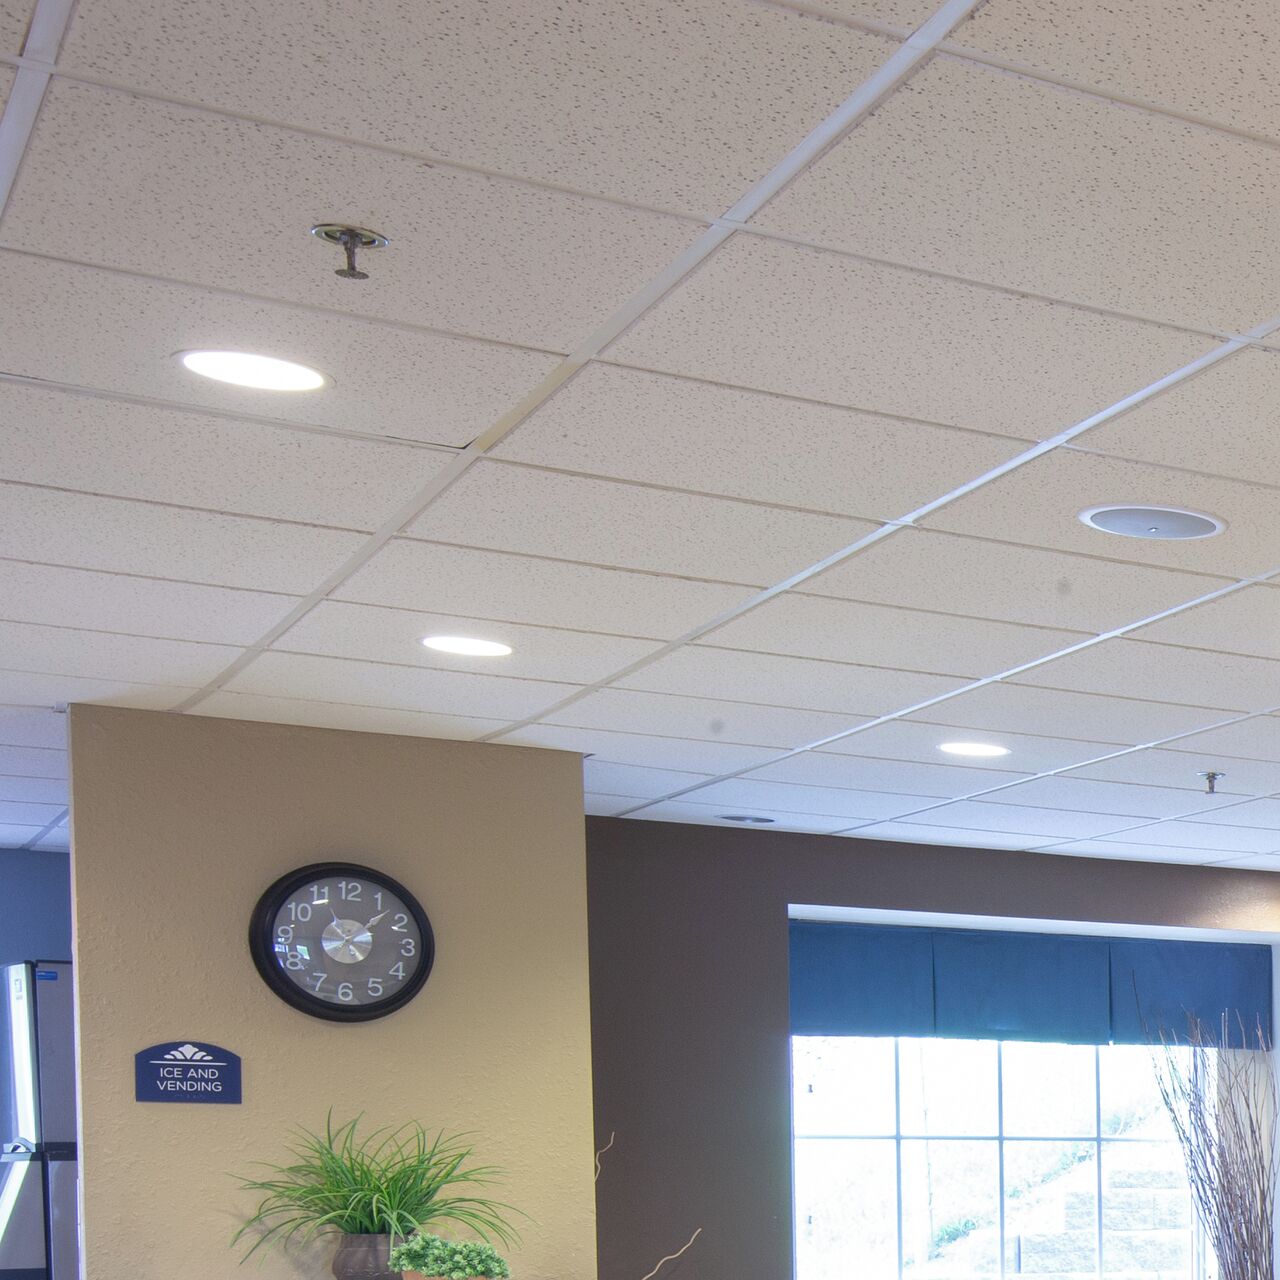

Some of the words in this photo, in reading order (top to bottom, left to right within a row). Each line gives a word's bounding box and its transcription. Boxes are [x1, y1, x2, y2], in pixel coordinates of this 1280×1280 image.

[310, 885, 329, 903] 11
[338, 881, 362, 901] 12
[374, 892, 382, 911] 1
[288, 902, 311, 921] 10
[393, 914, 408, 932] 2
[278, 926, 293, 944] 9
[401, 938, 415, 956] 3
[286, 951, 300, 970] 8
[389, 962, 405, 980] 4
[313, 973, 327, 991] 7
[368, 978, 383, 996] 5
[338, 983, 353, 1001] 6
[160, 1067, 183, 1078] ICE
[187, 1068, 219, 1079] AND
[156, 1080, 222, 1092] VENDING
